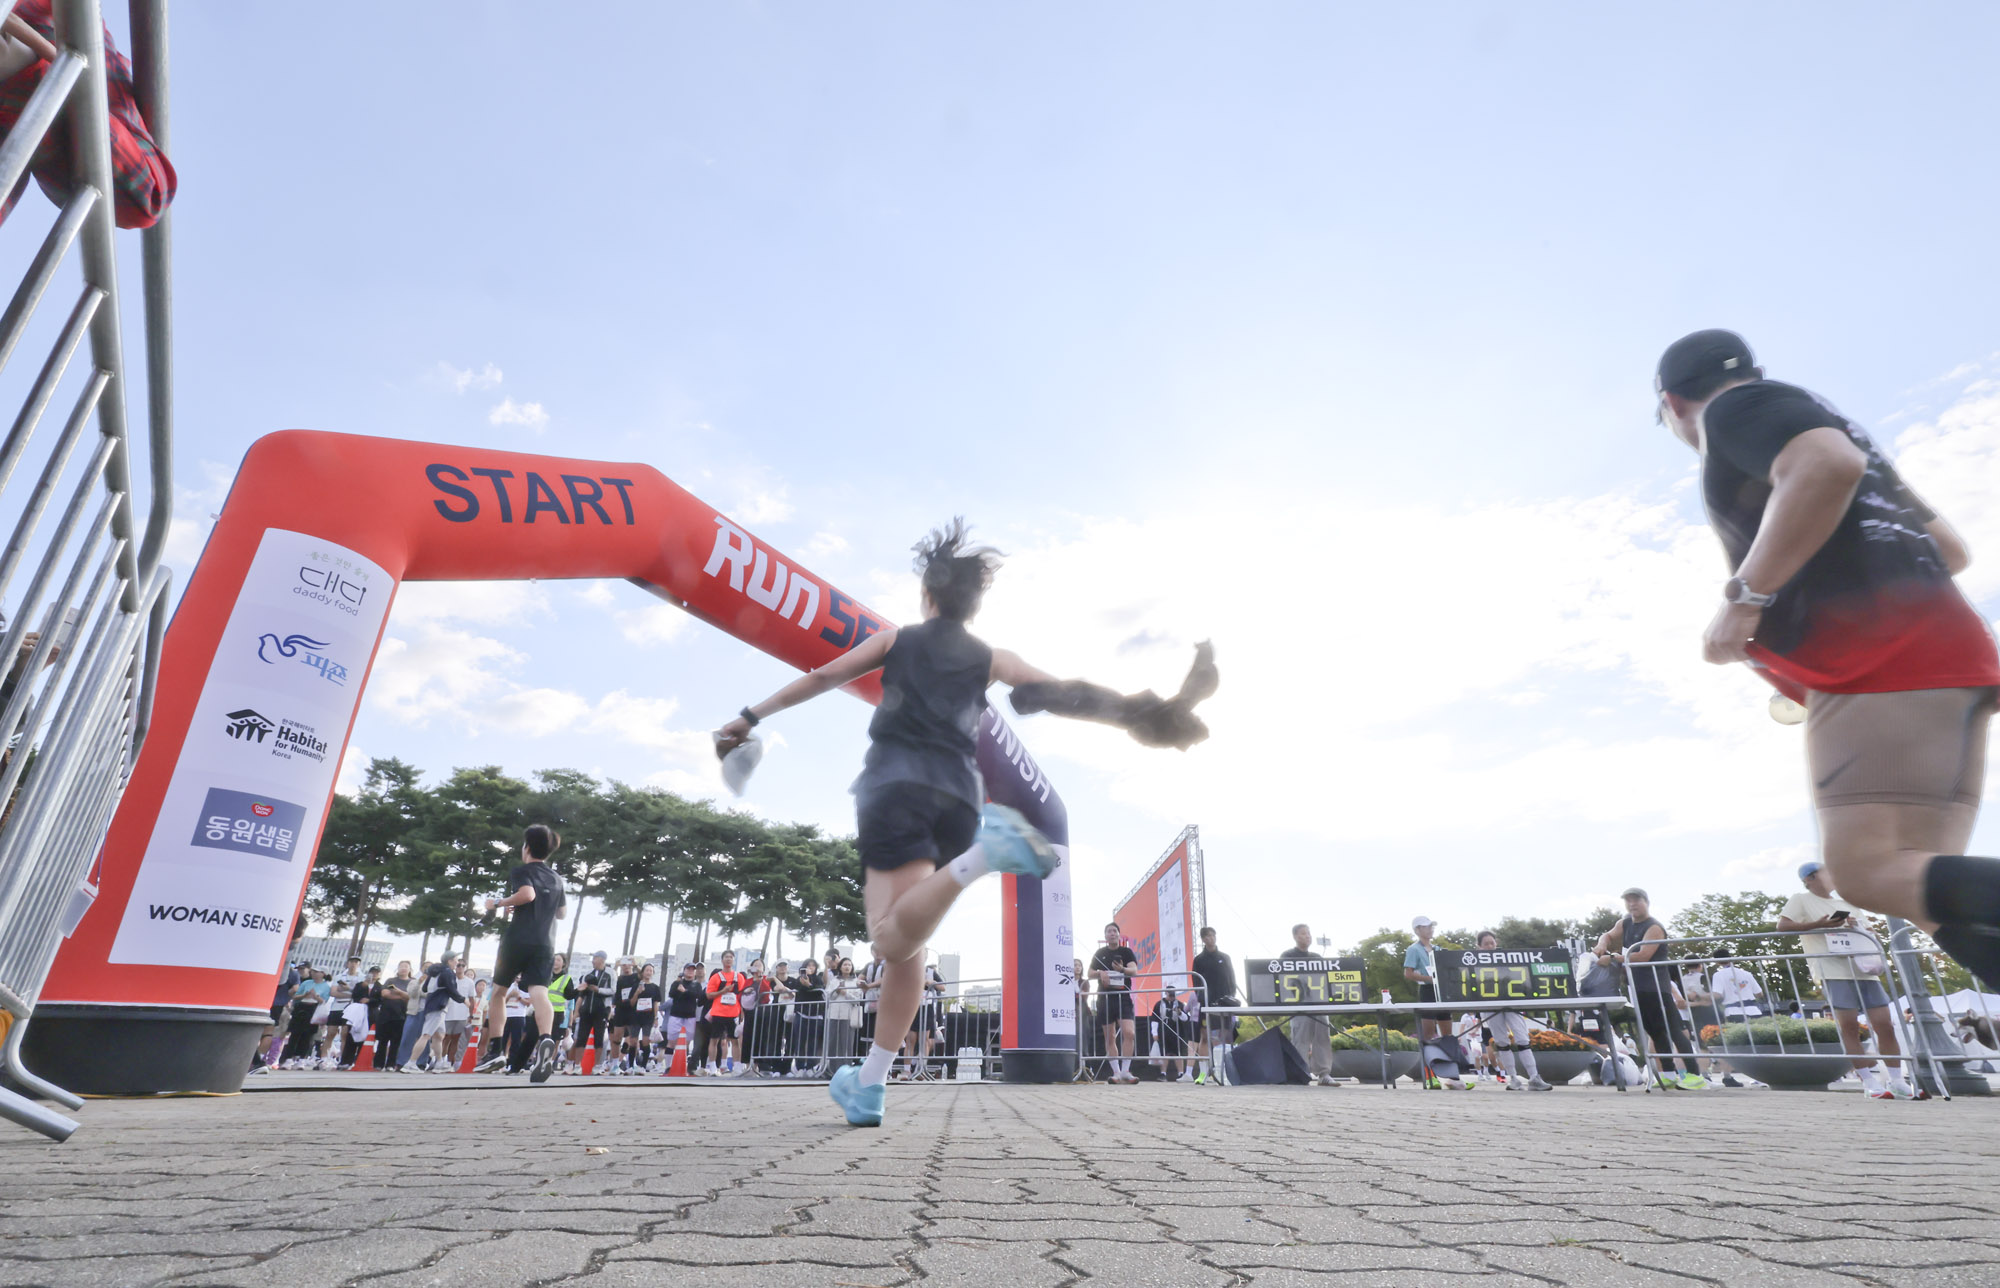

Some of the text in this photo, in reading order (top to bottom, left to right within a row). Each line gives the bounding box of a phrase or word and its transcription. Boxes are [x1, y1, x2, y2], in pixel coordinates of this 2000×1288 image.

[425, 463, 635, 526] START
[293, 586, 359, 616] daddy food
[300, 650, 349, 688] 피죤
[274, 740, 324, 763] for Humanity
[277, 726, 328, 754] Habitat
[271, 749, 292, 760] Korea
[986, 706, 1051, 804] INISH
[255, 809, 269, 817] WON
[205, 815, 293, 852] 동원샘물
[149, 904, 284, 934] WOMAN SENSE
[1283, 960, 1341, 971] SAMIK
[1478, 951, 1544, 963] SAMIK
[1536, 964, 1564, 973] 10km
[1334, 972, 1355, 981] 5km
